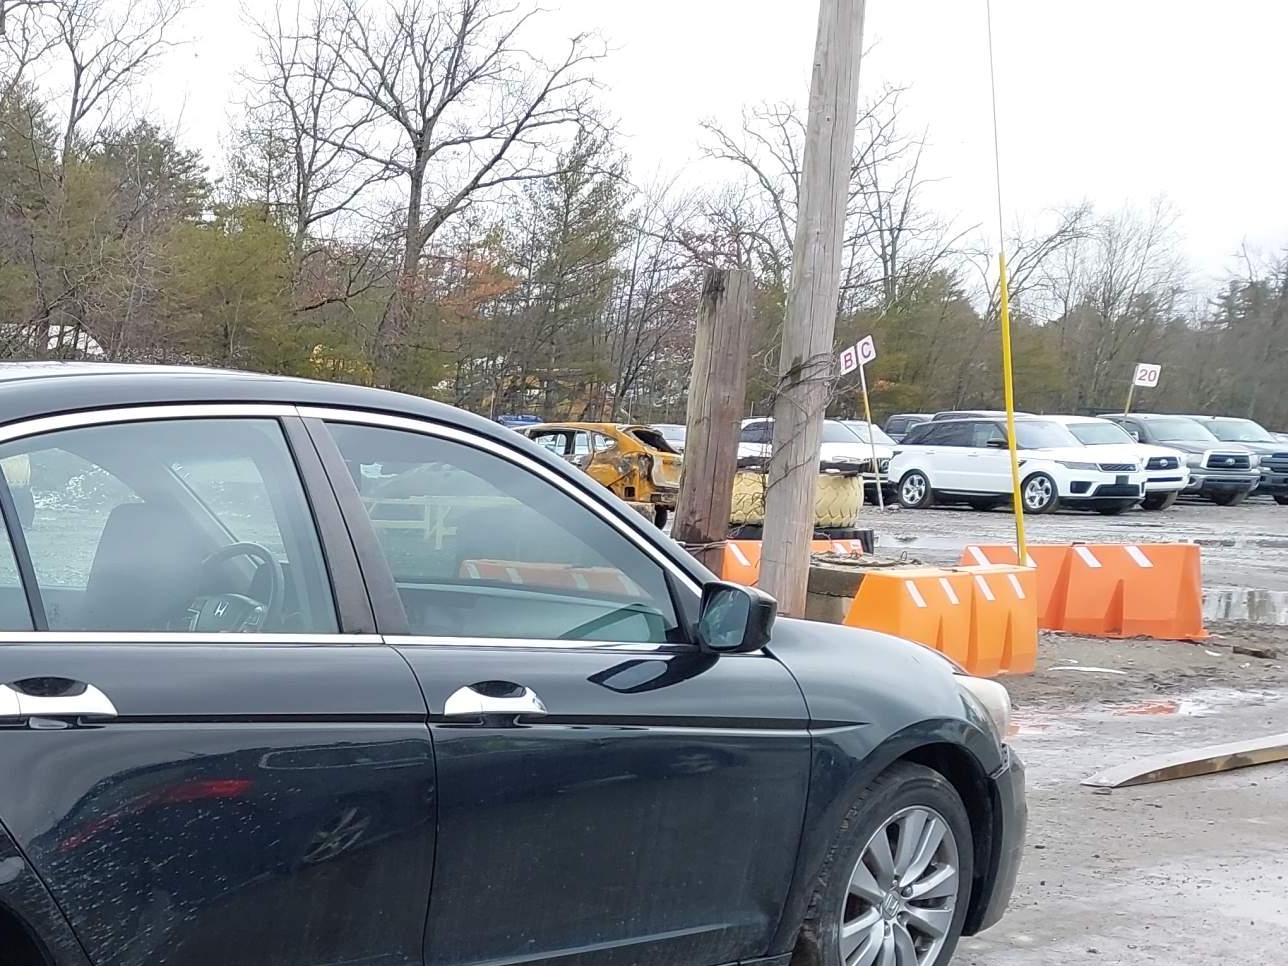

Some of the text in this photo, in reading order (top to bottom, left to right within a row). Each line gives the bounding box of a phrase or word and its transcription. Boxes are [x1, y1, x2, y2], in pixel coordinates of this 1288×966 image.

[861, 341, 872, 359] C
[844, 352, 853, 370] B
[1137, 369, 1157, 382] 20
